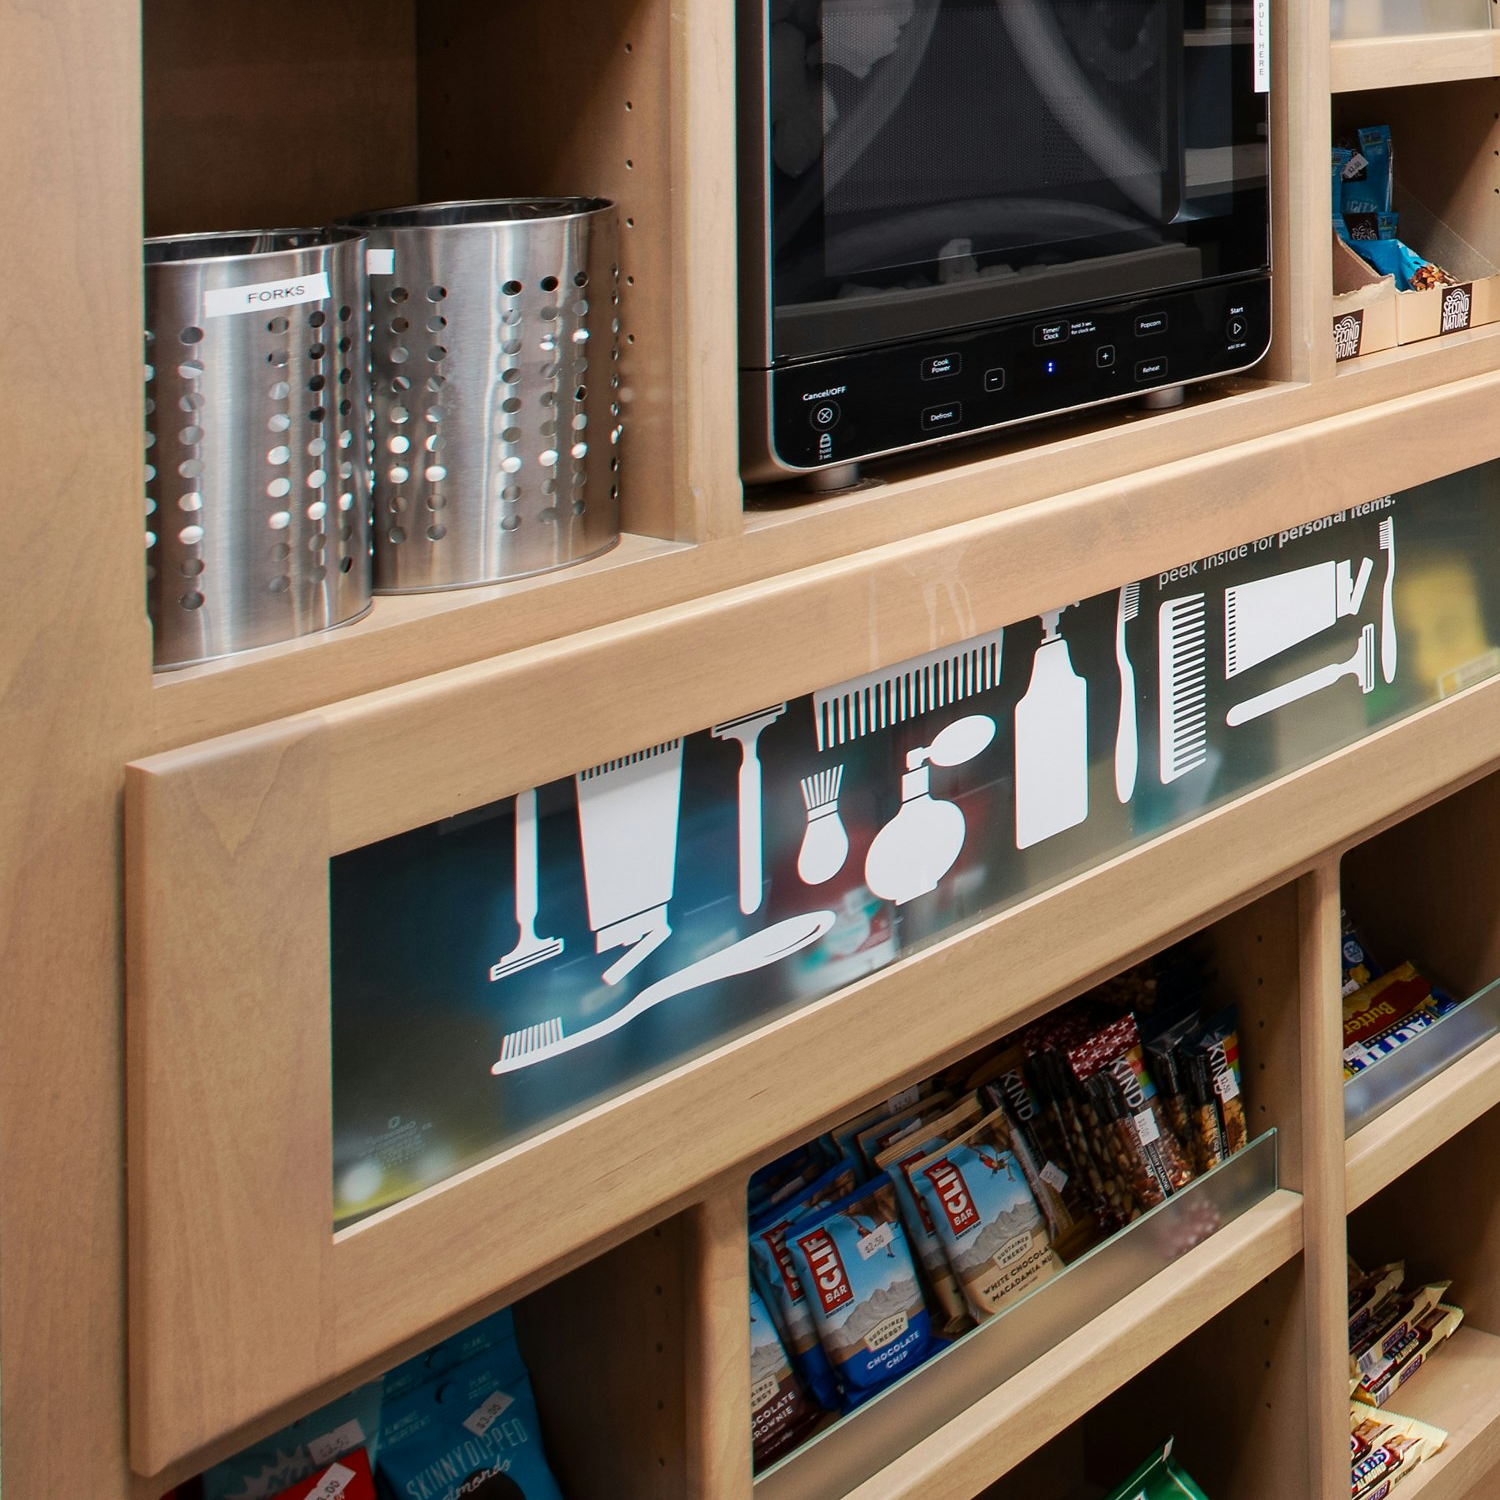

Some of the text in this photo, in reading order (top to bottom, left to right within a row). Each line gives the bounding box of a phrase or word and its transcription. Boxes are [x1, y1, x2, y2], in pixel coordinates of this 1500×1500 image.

[247, 284, 305, 304] FORKS
[1230, 306, 1243, 314] Start
[1443, 295, 1470, 316] SECOND
[1140, 320, 1161, 329] Popcorn
[1442, 312, 1468, 332] NATURE
[931, 365, 951, 374] Power
[933, 359, 949, 367] Cook
[1142, 364, 1160, 373] Reheat
[803, 386, 846, 401] Cancel/OFF
[930, 411, 952, 422] Defrost
[1158, 510, 1345, 590] peek personal
[1110, 1054, 1146, 1108] KIND
[1002, 1068, 1033, 1122] KIND
[930, 1165, 968, 1214] CLIF
[954, 1208, 974, 1226] BAR
[803, 1234, 842, 1292] CLIF
[1002, 1243, 1029, 1264] ENERGY
[983, 1272, 1010, 1295] WHITE
[992, 1262, 1041, 1302] MACADAMIA
[825, 1284, 847, 1304] BAR
[869, 1316, 905, 1342] SUSTAINED
[874, 1325, 903, 1347] ENERGY
[867, 1330, 920, 1370] CHOCOLATE
[885, 1350, 909, 1369] CHIP
